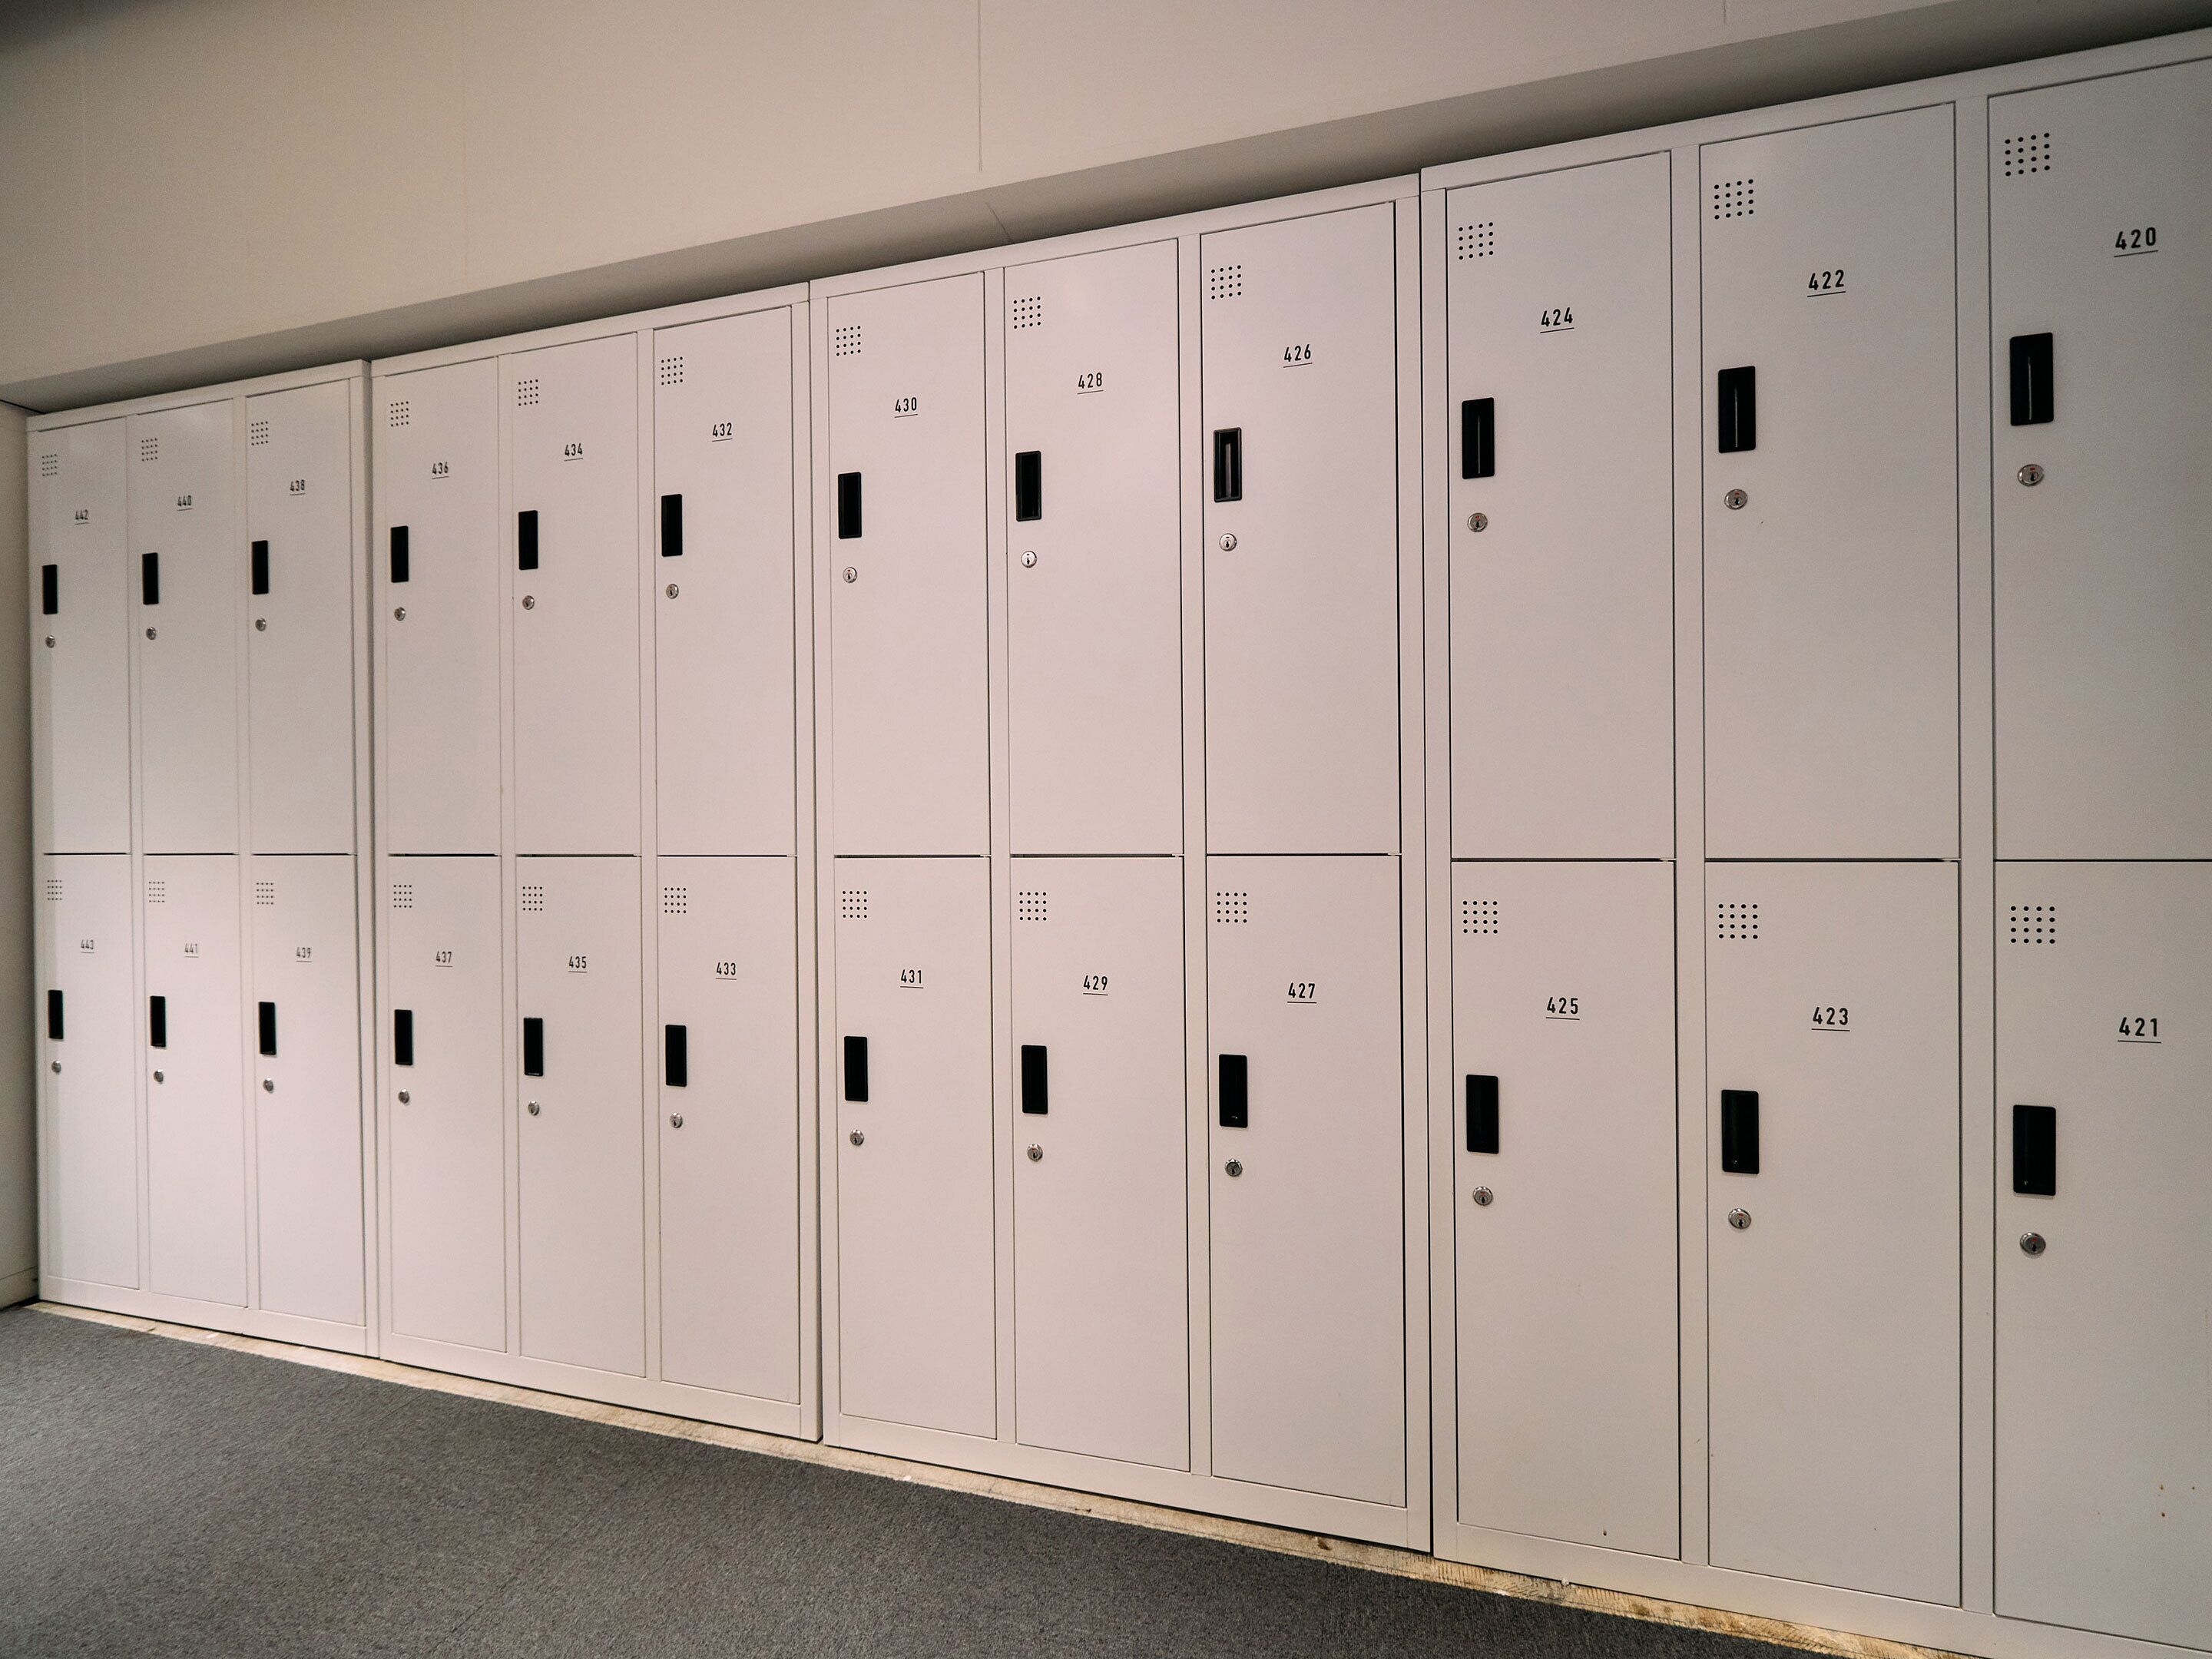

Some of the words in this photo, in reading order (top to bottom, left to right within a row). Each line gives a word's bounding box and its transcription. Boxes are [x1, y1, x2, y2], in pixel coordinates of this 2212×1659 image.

[2114, 227, 2157, 250] 420
[1808, 269, 1845, 291] 422
[1541, 306, 1574, 327] 424
[1283, 343, 1311, 363] 426
[1078, 372, 1103, 389] 428
[895, 396, 917, 413] 430
[712, 422, 732, 438] 432
[564, 442, 583, 457] 434
[432, 462, 449, 475] 436
[290, 478, 305, 492] 438
[177, 495, 192, 507] 440
[75, 509, 88, 521] 442
[80, 939, 94, 951] 443
[184, 942, 199, 955] 441
[296, 946, 312, 959] 439
[435, 951, 452, 963] 437
[568, 955, 587, 969] 435
[716, 962, 737, 976] 433
[900, 969, 922, 984] 431
[1083, 975, 1108, 991] 429
[1287, 982, 1316, 999] 427
[1546, 996, 1578, 1015] 425
[1812, 1006, 1849, 1025] 423
[2118, 1016, 2157, 1038] 421
